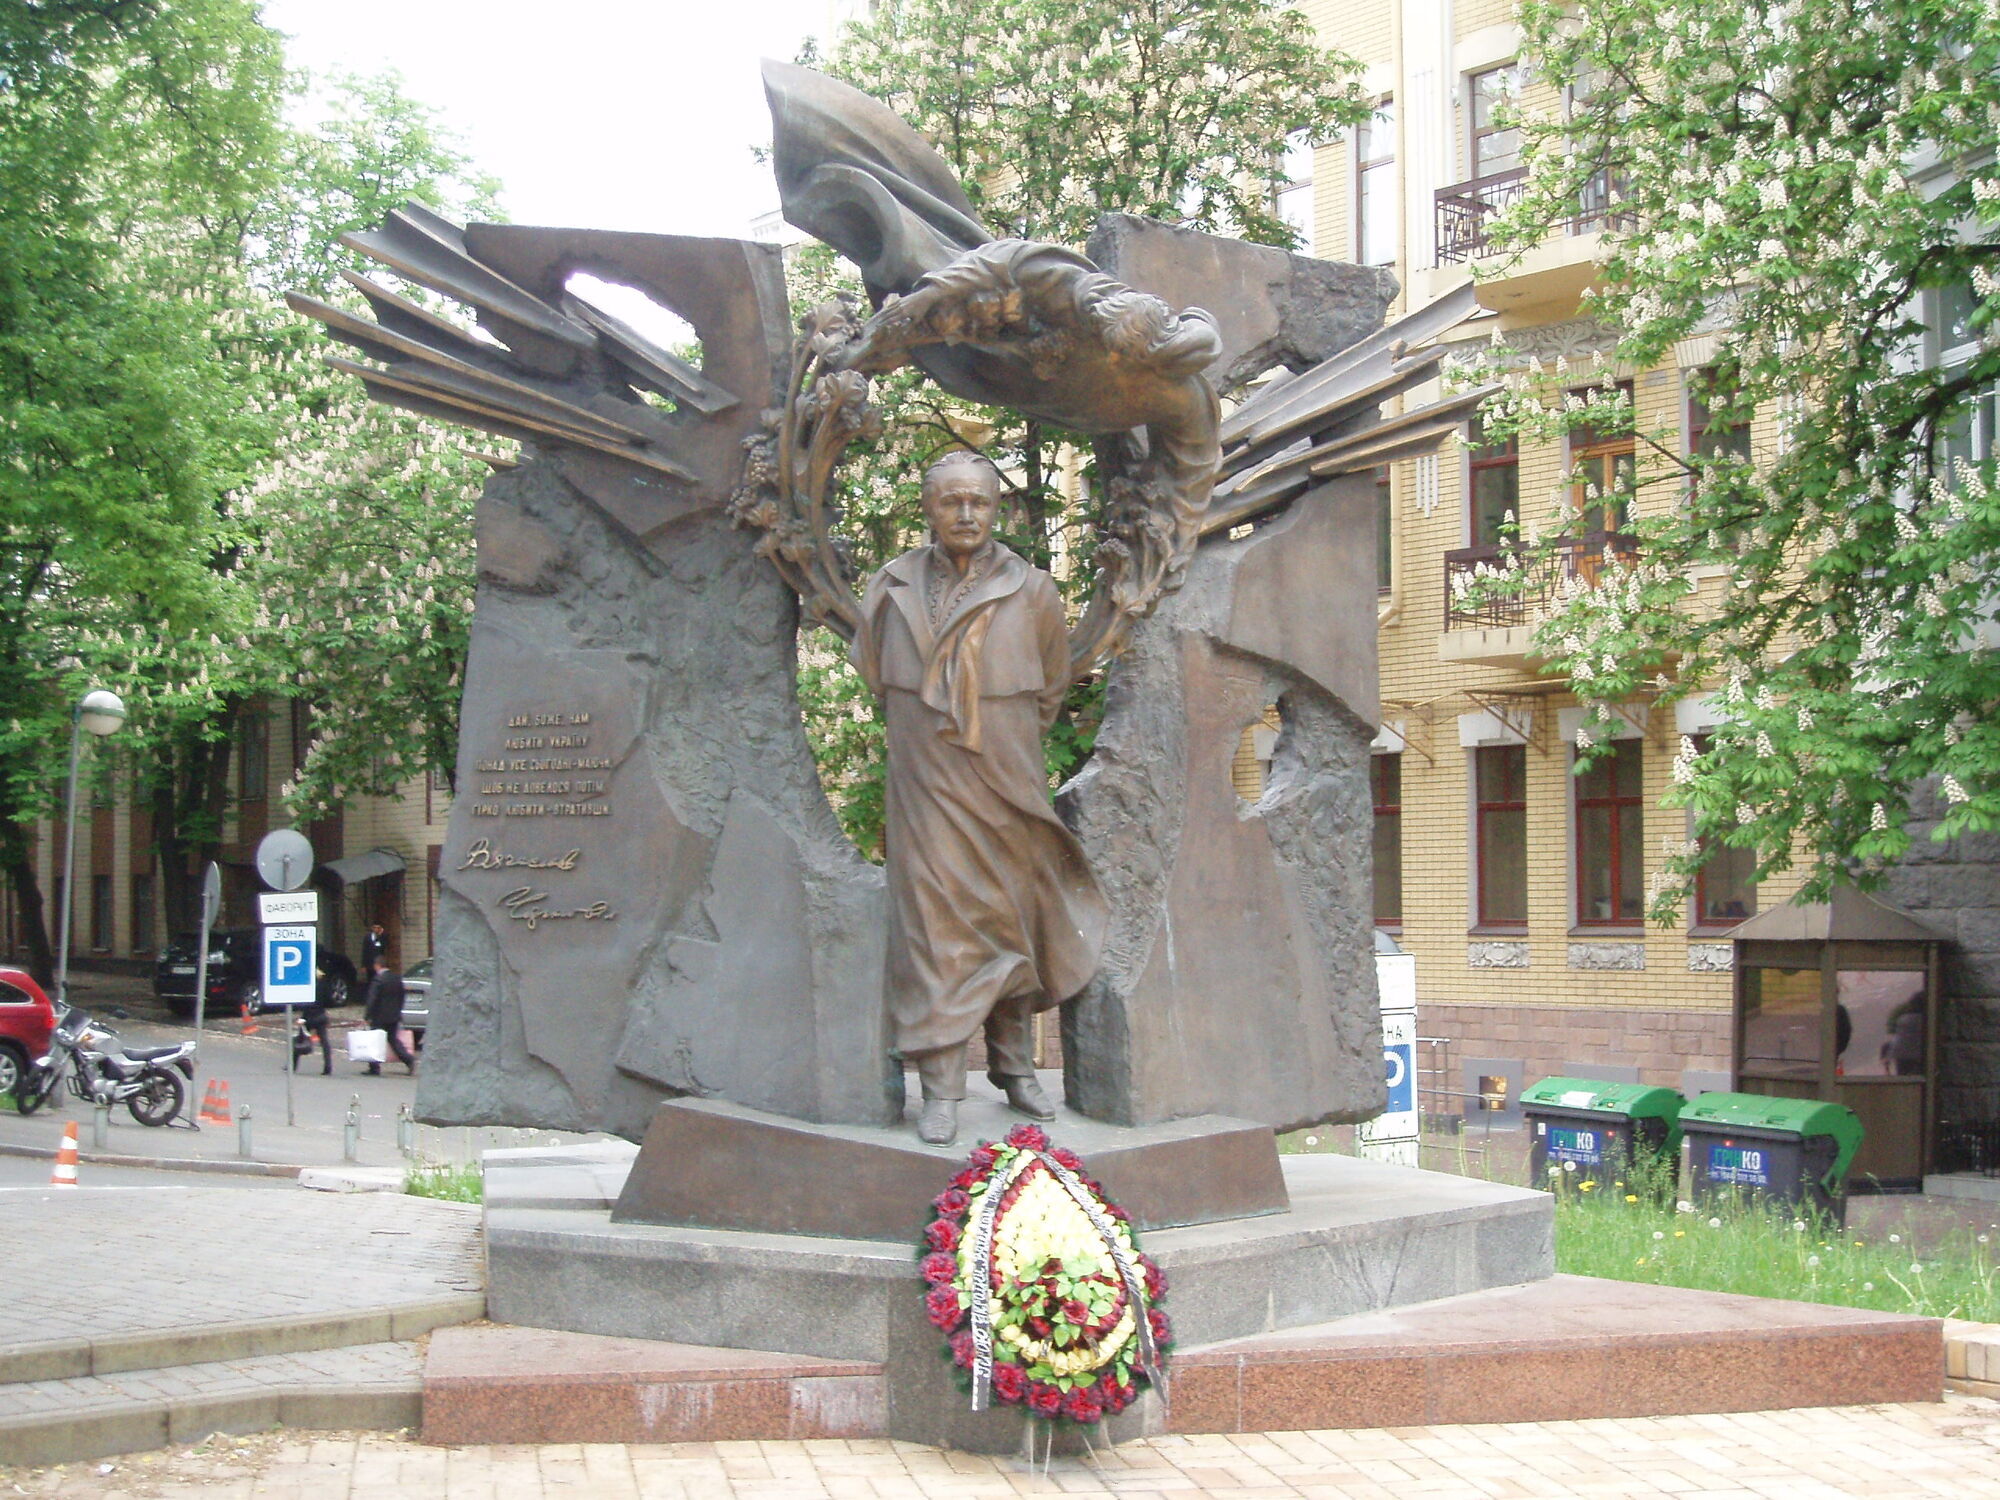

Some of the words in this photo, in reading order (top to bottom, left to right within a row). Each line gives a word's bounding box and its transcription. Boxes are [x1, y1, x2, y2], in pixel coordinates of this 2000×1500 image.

[569, 712, 589, 725] НАМ
[505, 737, 544, 750] ЛЮБИТИ
[550, 733, 588, 748] УКРАЇНУ
[476, 759, 505, 772] ПОНАД
[511, 759, 527, 771] УСЕ
[481, 782, 504, 794] ЩОБ
[507, 782, 520, 794] НЕ
[523, 780, 570, 794] ДОВЕЛОСЯ
[472, 803, 499, 817] ГІРКО
[506, 803, 544, 817] ЛЮБИТИ
[265, 901, 314, 913] ФАВОРИТ
[274, 928, 305, 939] ЗОНА
